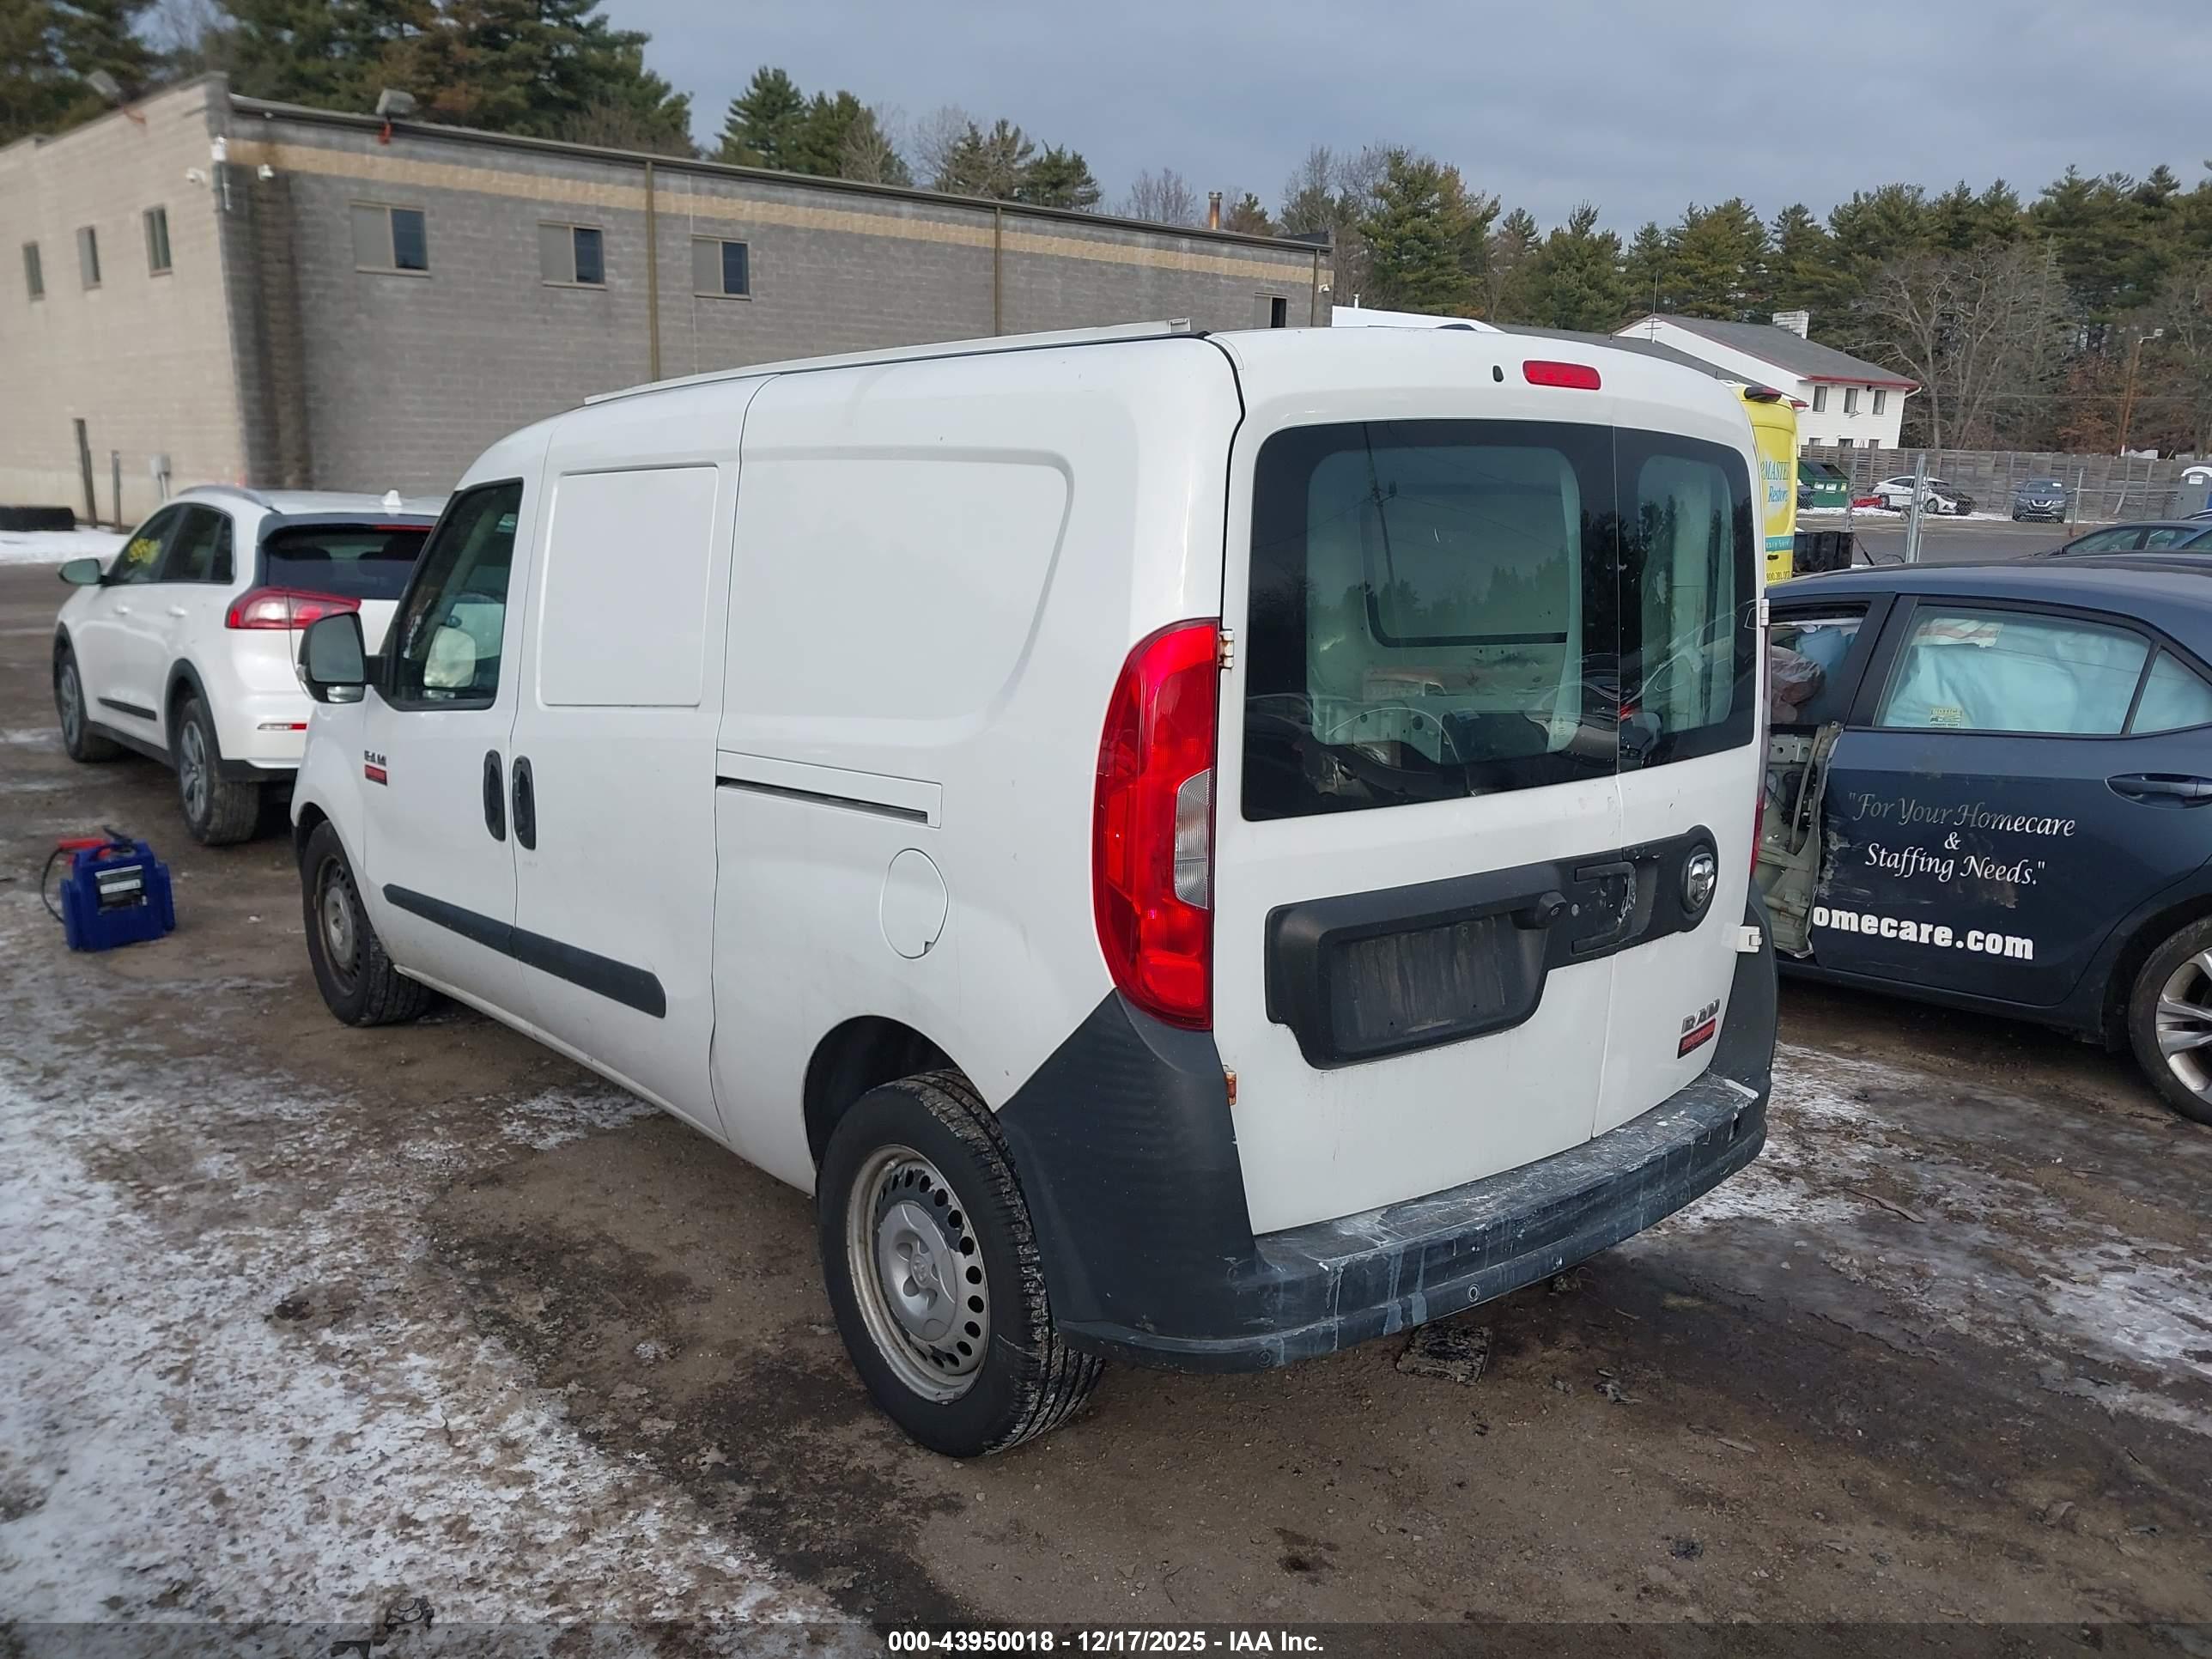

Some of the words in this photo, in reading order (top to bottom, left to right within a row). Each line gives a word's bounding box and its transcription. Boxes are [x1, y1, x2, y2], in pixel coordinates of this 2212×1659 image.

[1849, 793, 1894, 821] "For
[1898, 797, 1953, 825] Your
[1953, 802, 2075, 836] Homecare
[1944, 831, 1962, 850] &
[1864, 842, 1954, 883] Staffing
[1960, 855, 2045, 885] Needs."
[1813, 906, 2033, 960] omecare.com
